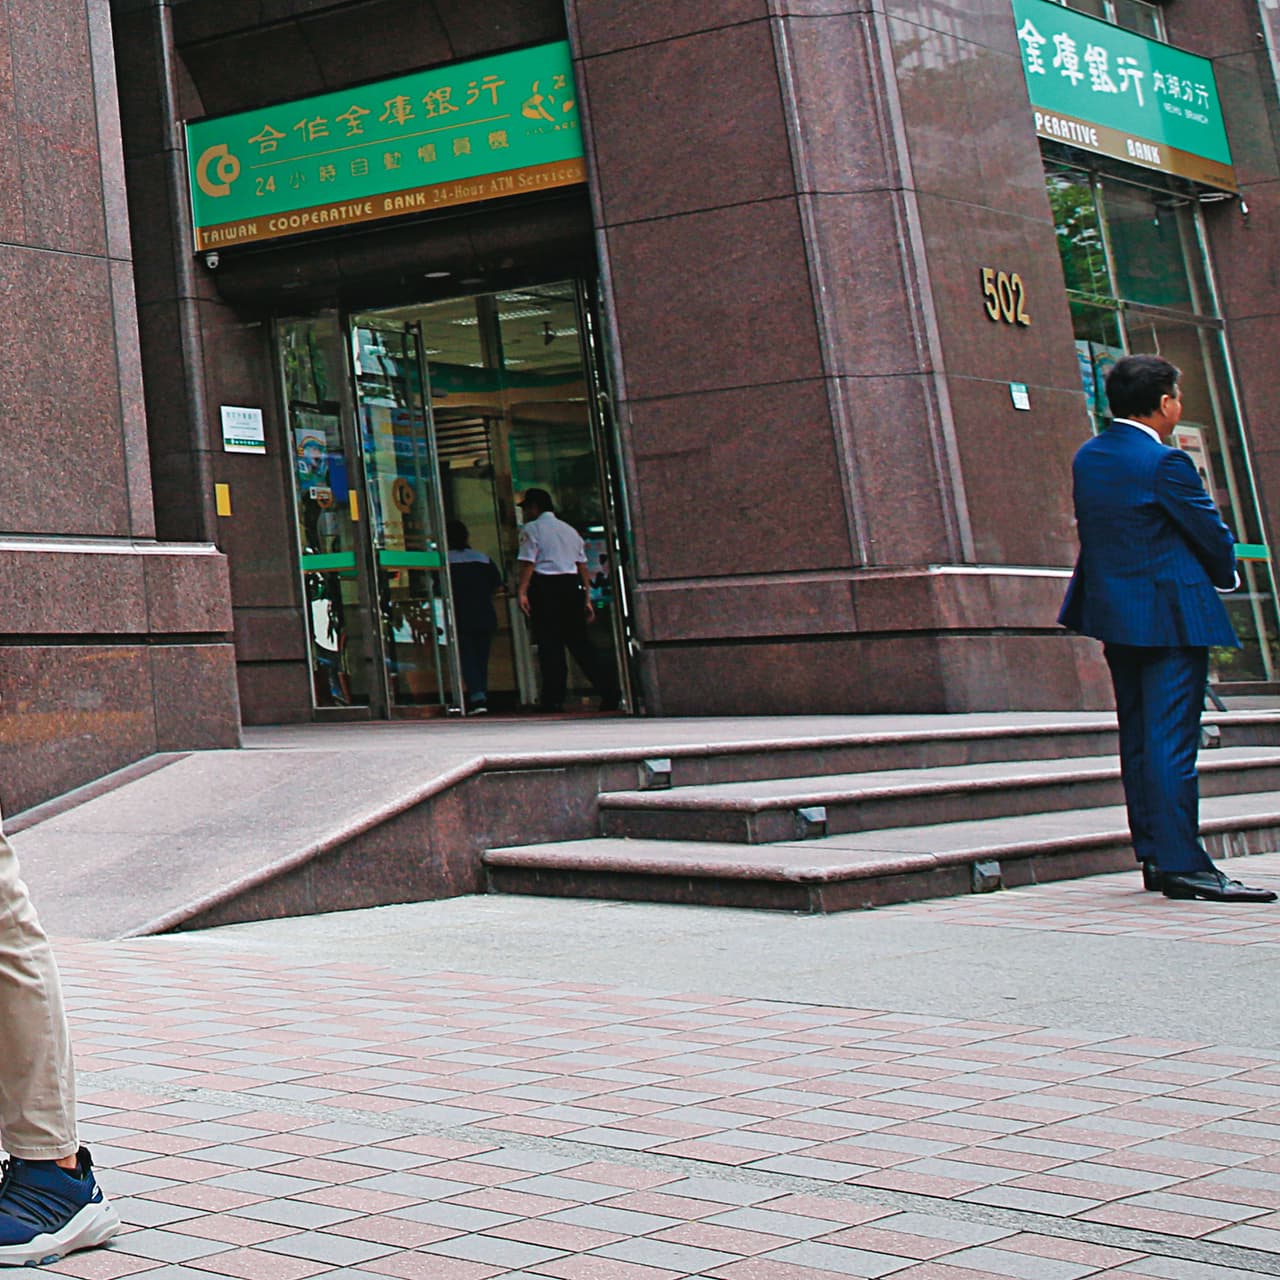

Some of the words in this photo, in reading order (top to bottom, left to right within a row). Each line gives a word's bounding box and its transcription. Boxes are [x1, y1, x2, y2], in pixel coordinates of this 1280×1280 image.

[248, 75, 506, 154] 合作金庫銀行
[1034, 112, 1099, 147] PERATIVE
[1126, 139, 1160, 164] BANK
[203, 223, 257, 244] TAIWAN
[269, 201, 373, 232] COOPERATIVE
[384, 192, 426, 211] BANK
[433, 183, 485, 203] 24-Hour
[490, 175, 513, 192] ATM
[519, 167, 582, 188] Services
[981, 267, 1032, 327] 502
